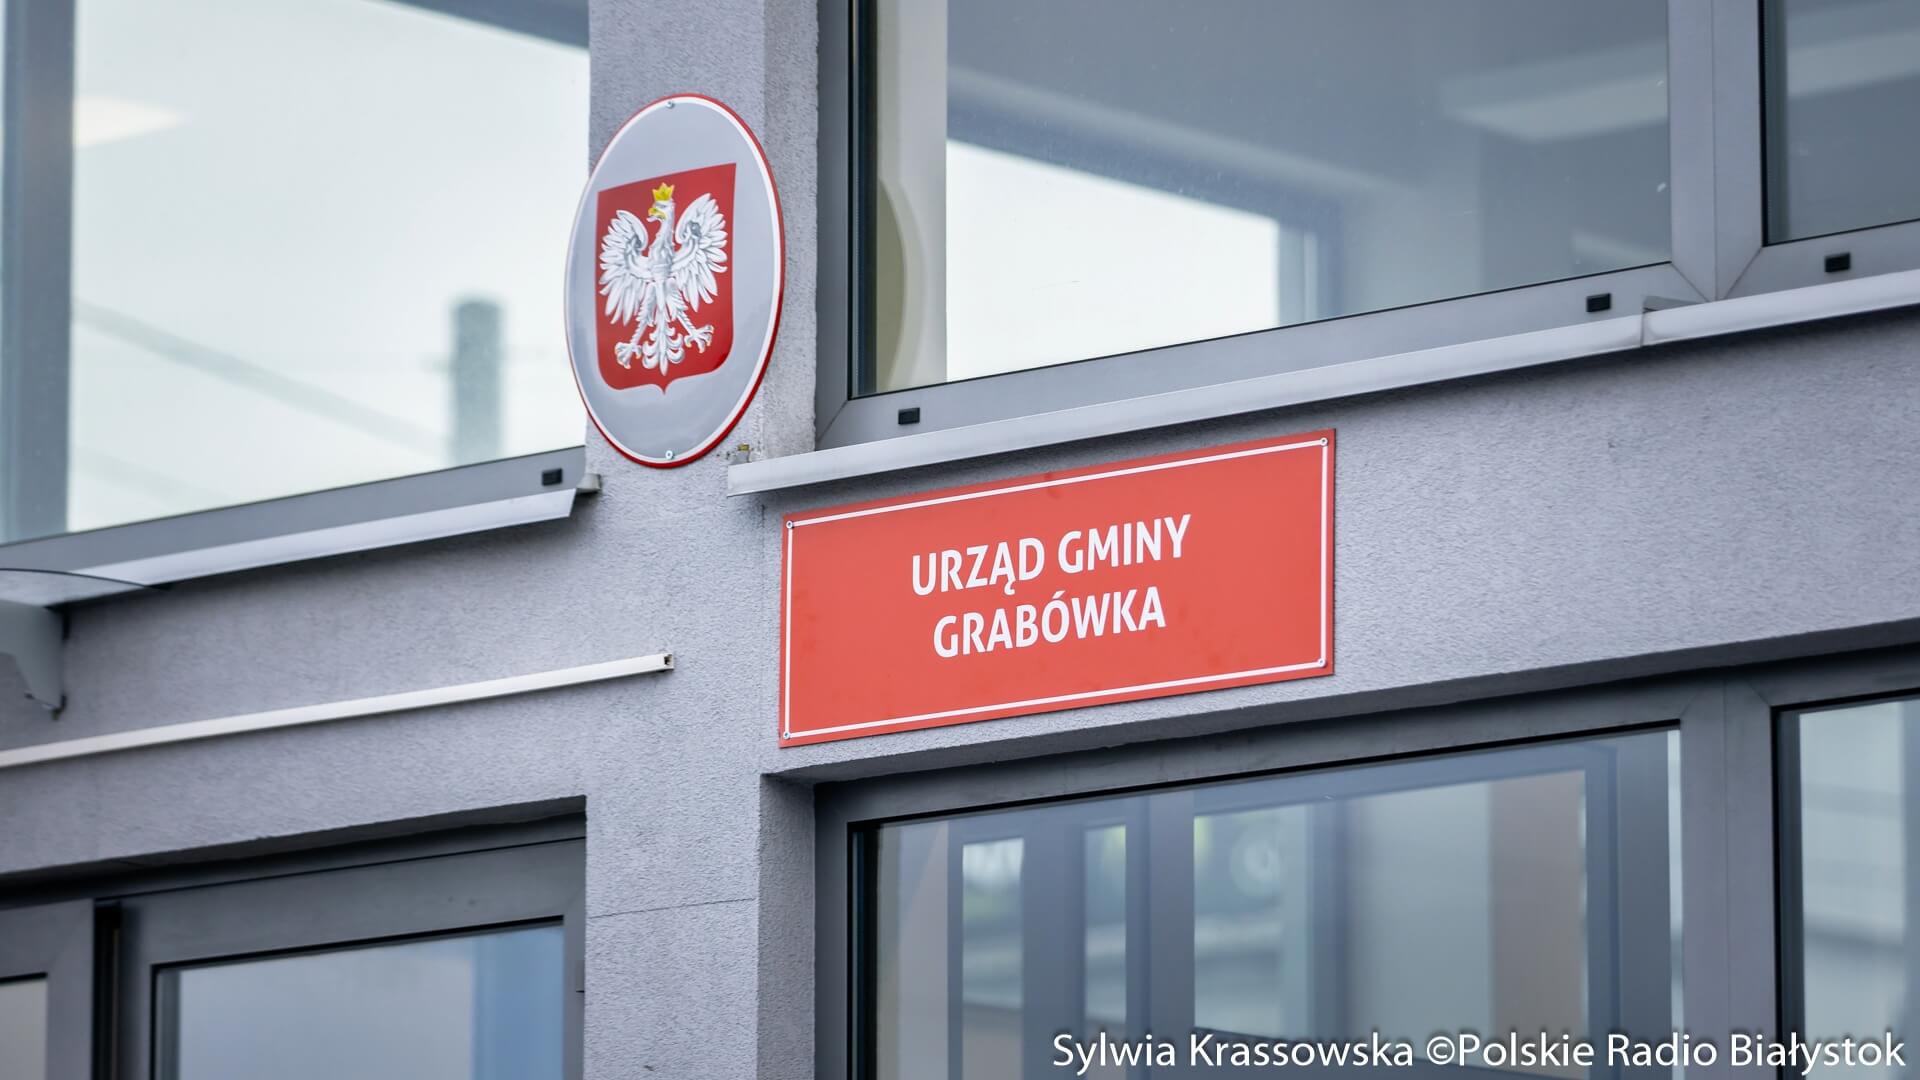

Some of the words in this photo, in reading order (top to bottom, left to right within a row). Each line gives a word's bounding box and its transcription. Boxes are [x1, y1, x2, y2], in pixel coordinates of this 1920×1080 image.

[911, 537, 1045, 597] URZĄD
[1058, 514, 1191, 574] GMINY
[933, 586, 1166, 658] GRABÓWKA
